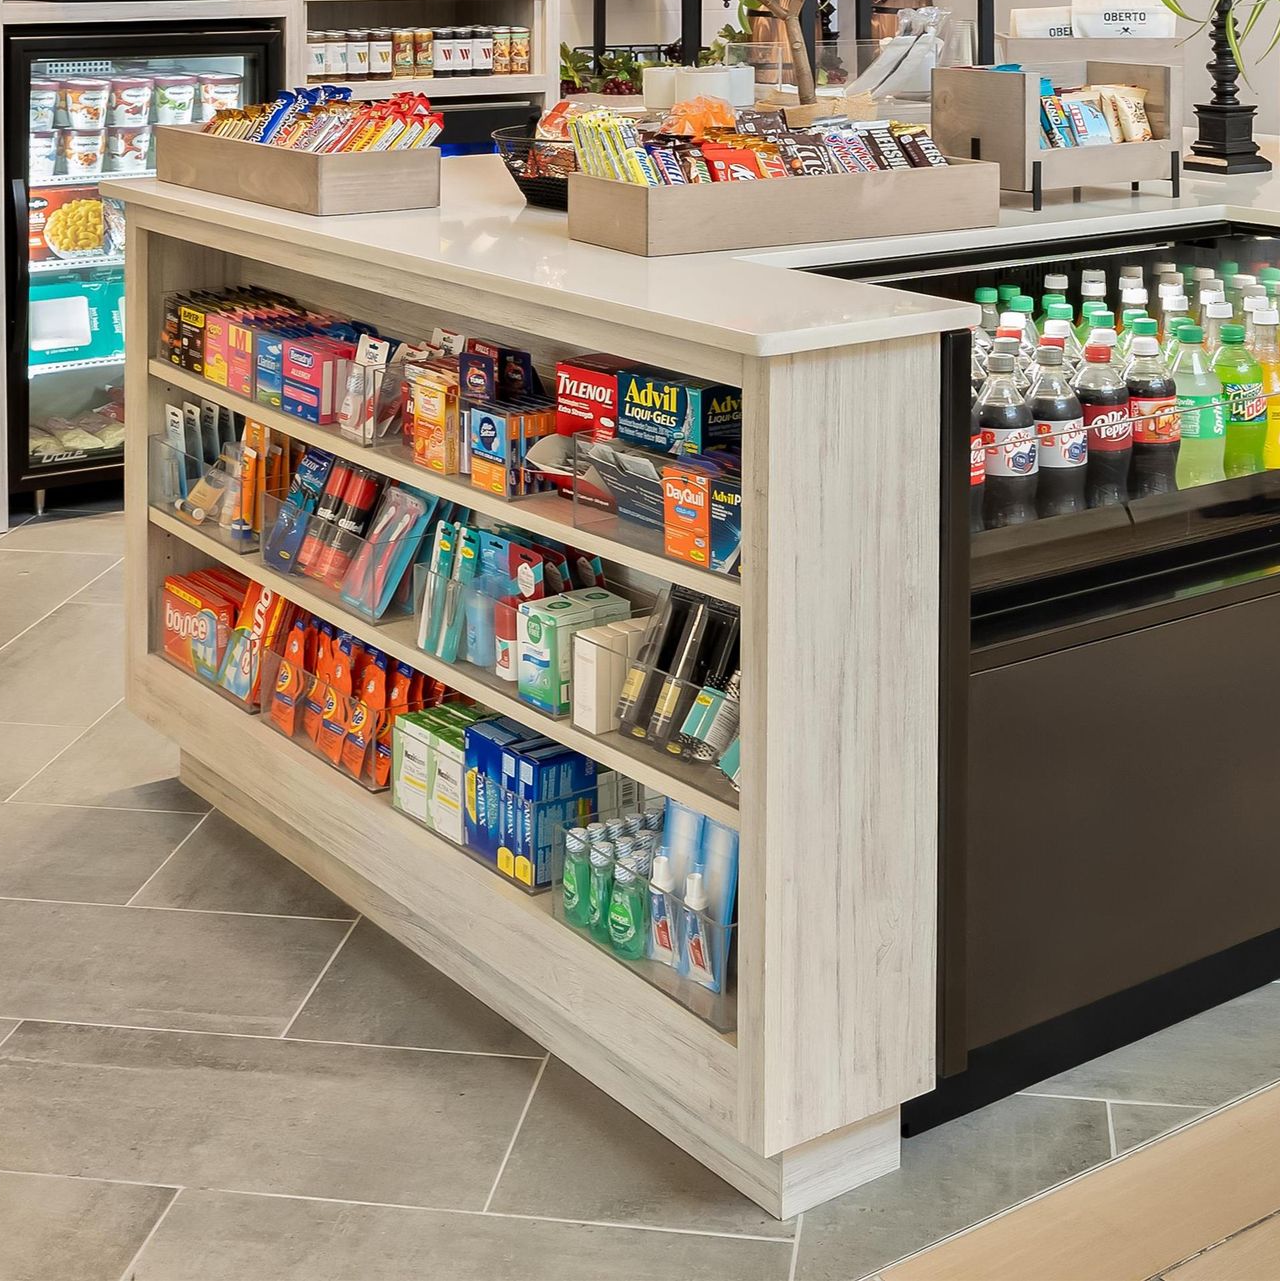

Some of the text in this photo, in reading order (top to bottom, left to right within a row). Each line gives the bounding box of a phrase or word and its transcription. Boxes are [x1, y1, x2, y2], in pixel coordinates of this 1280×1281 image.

[1104, 12, 1146, 22] OBERTO
[1043, 96, 1061, 125] KIND
[290, 350, 313, 367] Benadryl
[557, 372, 613, 405] TYLENOL
[624, 378, 678, 413] Advil
[558, 404, 594, 420] Extra Strength
[625, 404, 677, 428] LIQUI-GELS
[1212, 397, 1224, 435] Sprite
[666, 482, 704, 508] DayQuil
[712, 489, 734, 506] Advil
[166, 600, 208, 642] bounce
[242, 586, 272, 675] ounce
[476, 773, 486, 826] TAMPAX
[506, 792, 514, 834] TAMPAX
[523, 799, 531, 844] TAMPAX
